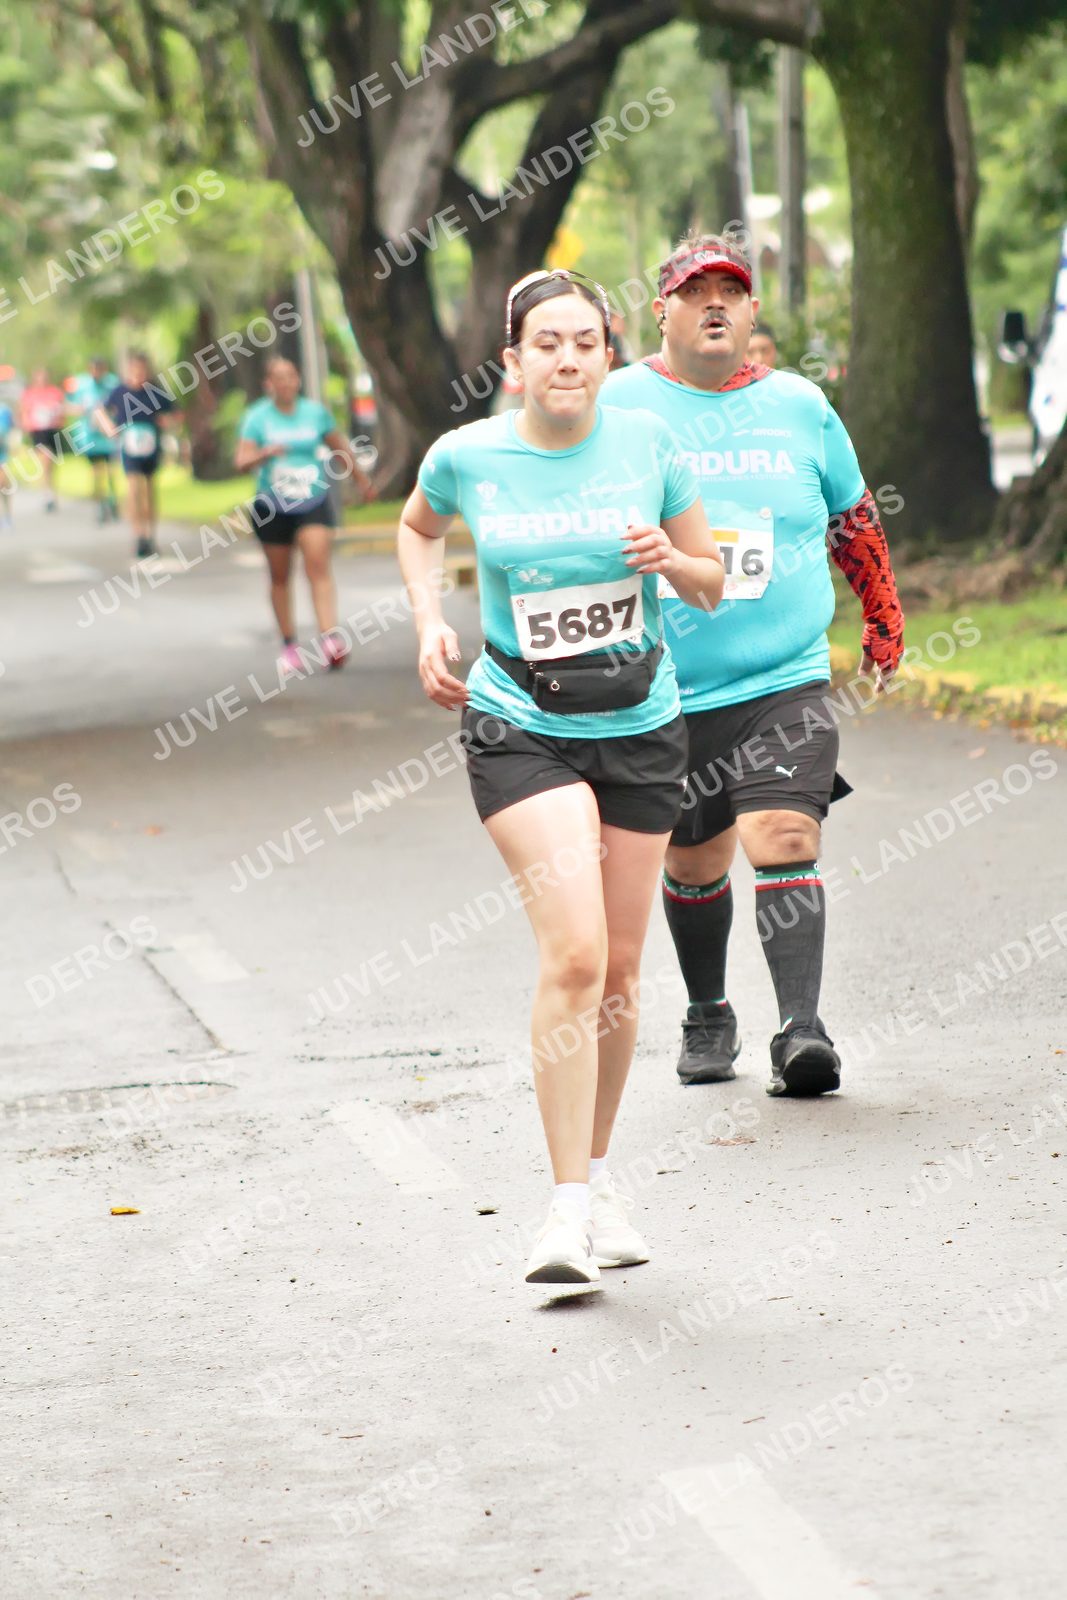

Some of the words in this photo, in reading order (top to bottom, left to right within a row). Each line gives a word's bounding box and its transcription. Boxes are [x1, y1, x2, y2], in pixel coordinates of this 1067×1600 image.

[674, 449, 797, 476] RDURA
[719, 546, 764, 577] 16
[527, 594, 637, 649] 5687
